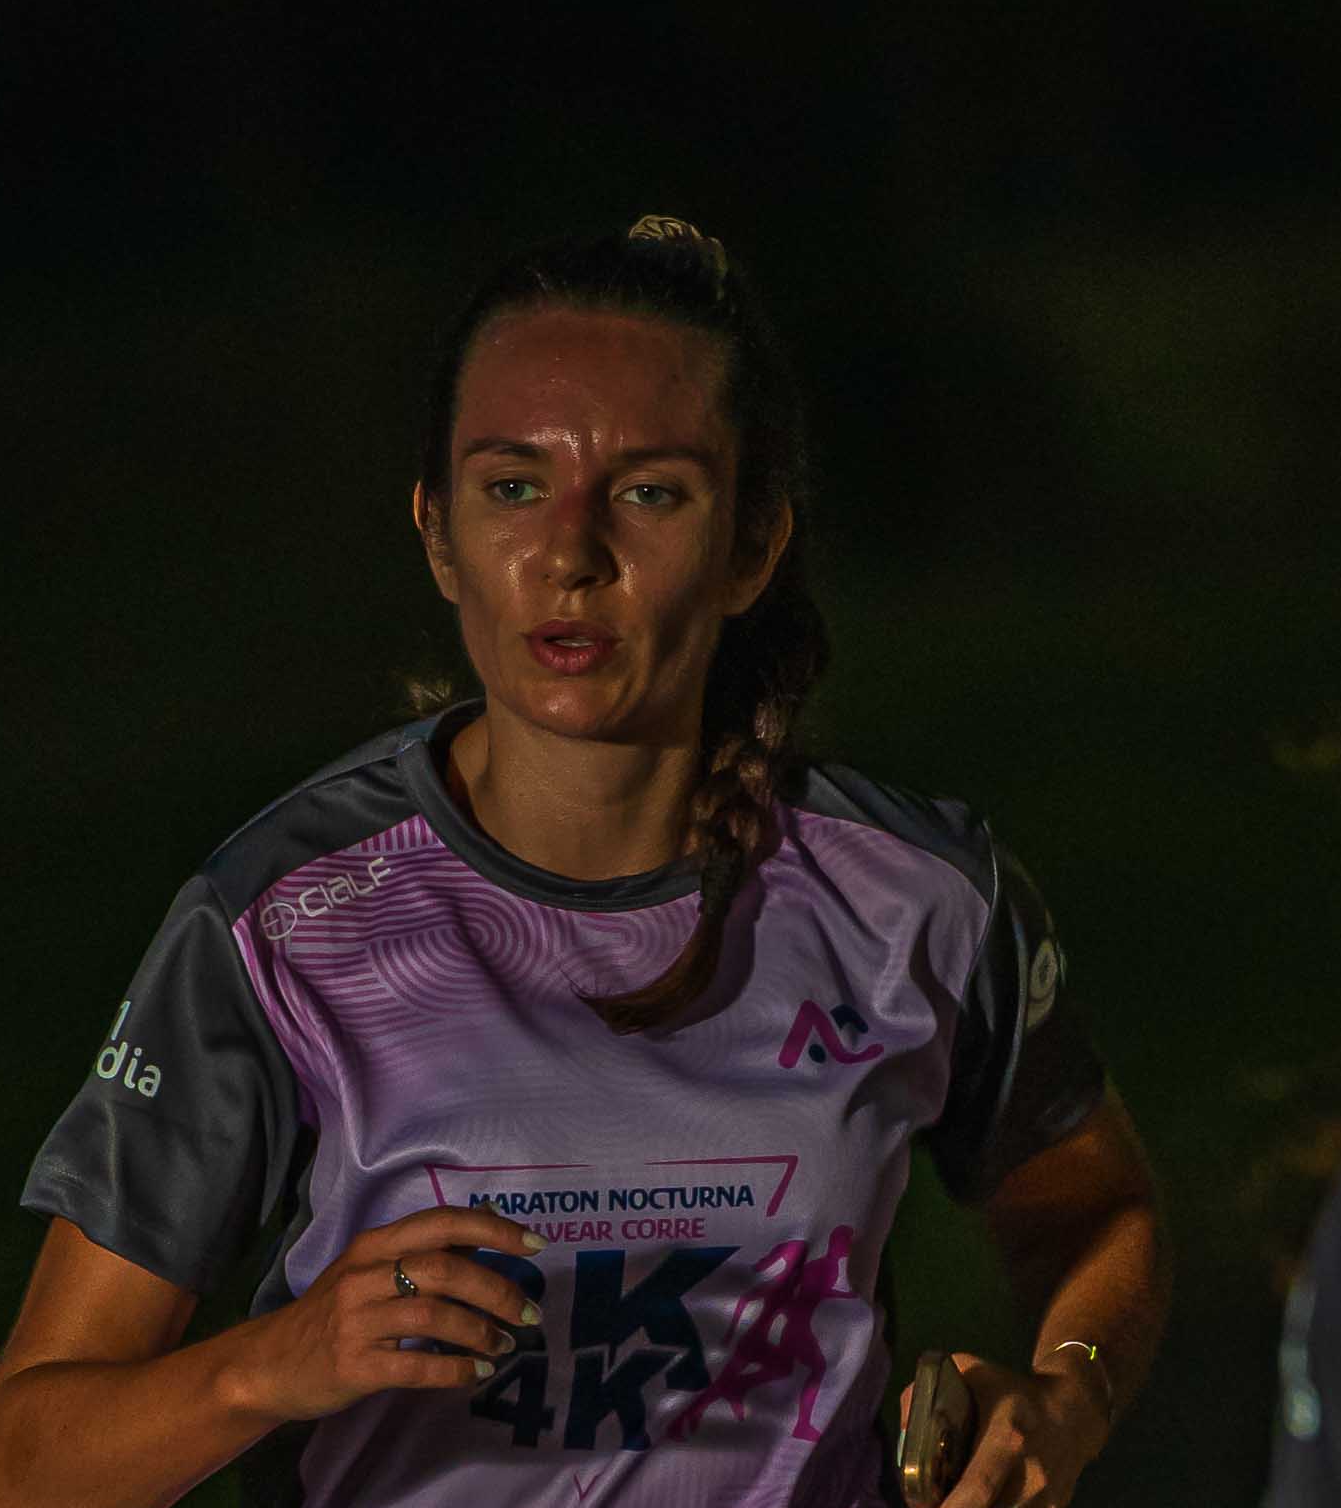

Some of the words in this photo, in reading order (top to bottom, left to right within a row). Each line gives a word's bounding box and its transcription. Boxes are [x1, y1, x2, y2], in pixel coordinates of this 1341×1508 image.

[468, 1190, 599, 1215] MARATON
[608, 1185, 755, 1212] NOCTURNA
[621, 1218, 707, 1241] CORRE
[469, 1354, 684, 1450] 4K
